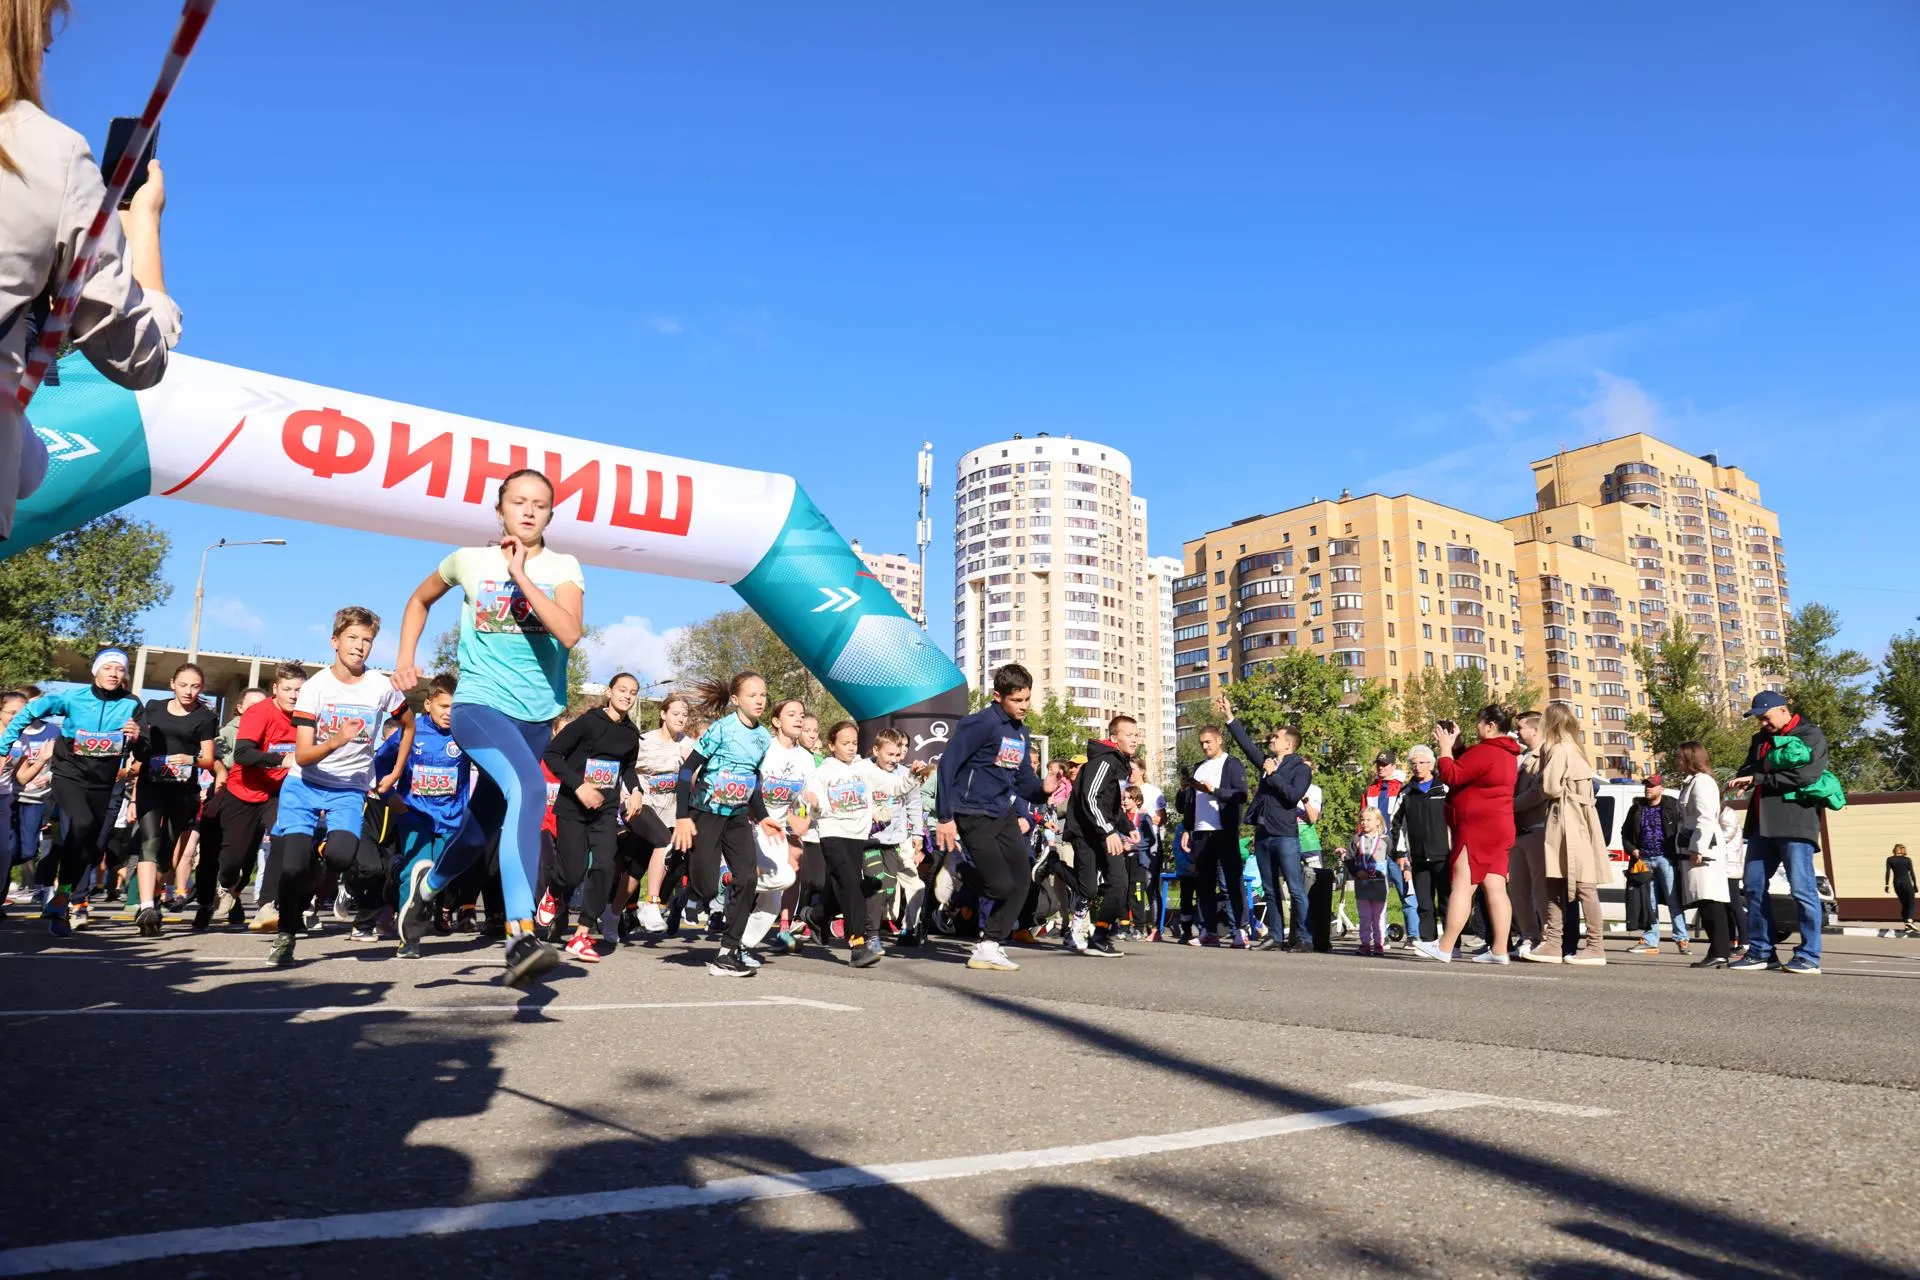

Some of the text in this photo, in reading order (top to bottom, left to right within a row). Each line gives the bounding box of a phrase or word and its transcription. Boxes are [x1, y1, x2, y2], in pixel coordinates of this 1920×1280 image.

[282, 407, 693, 537] ФИНИШ
[496, 596, 533, 622] 79
[86, 738, 112, 751] 99
[160, 764, 180, 777] 76
[593, 768, 611, 783] 86
[419, 774, 451, 789] 133
[658, 780, 676, 790] 94
[726, 782, 747, 798] 98
[773, 786, 790, 800] 91
[841, 790, 859, 805] 71
